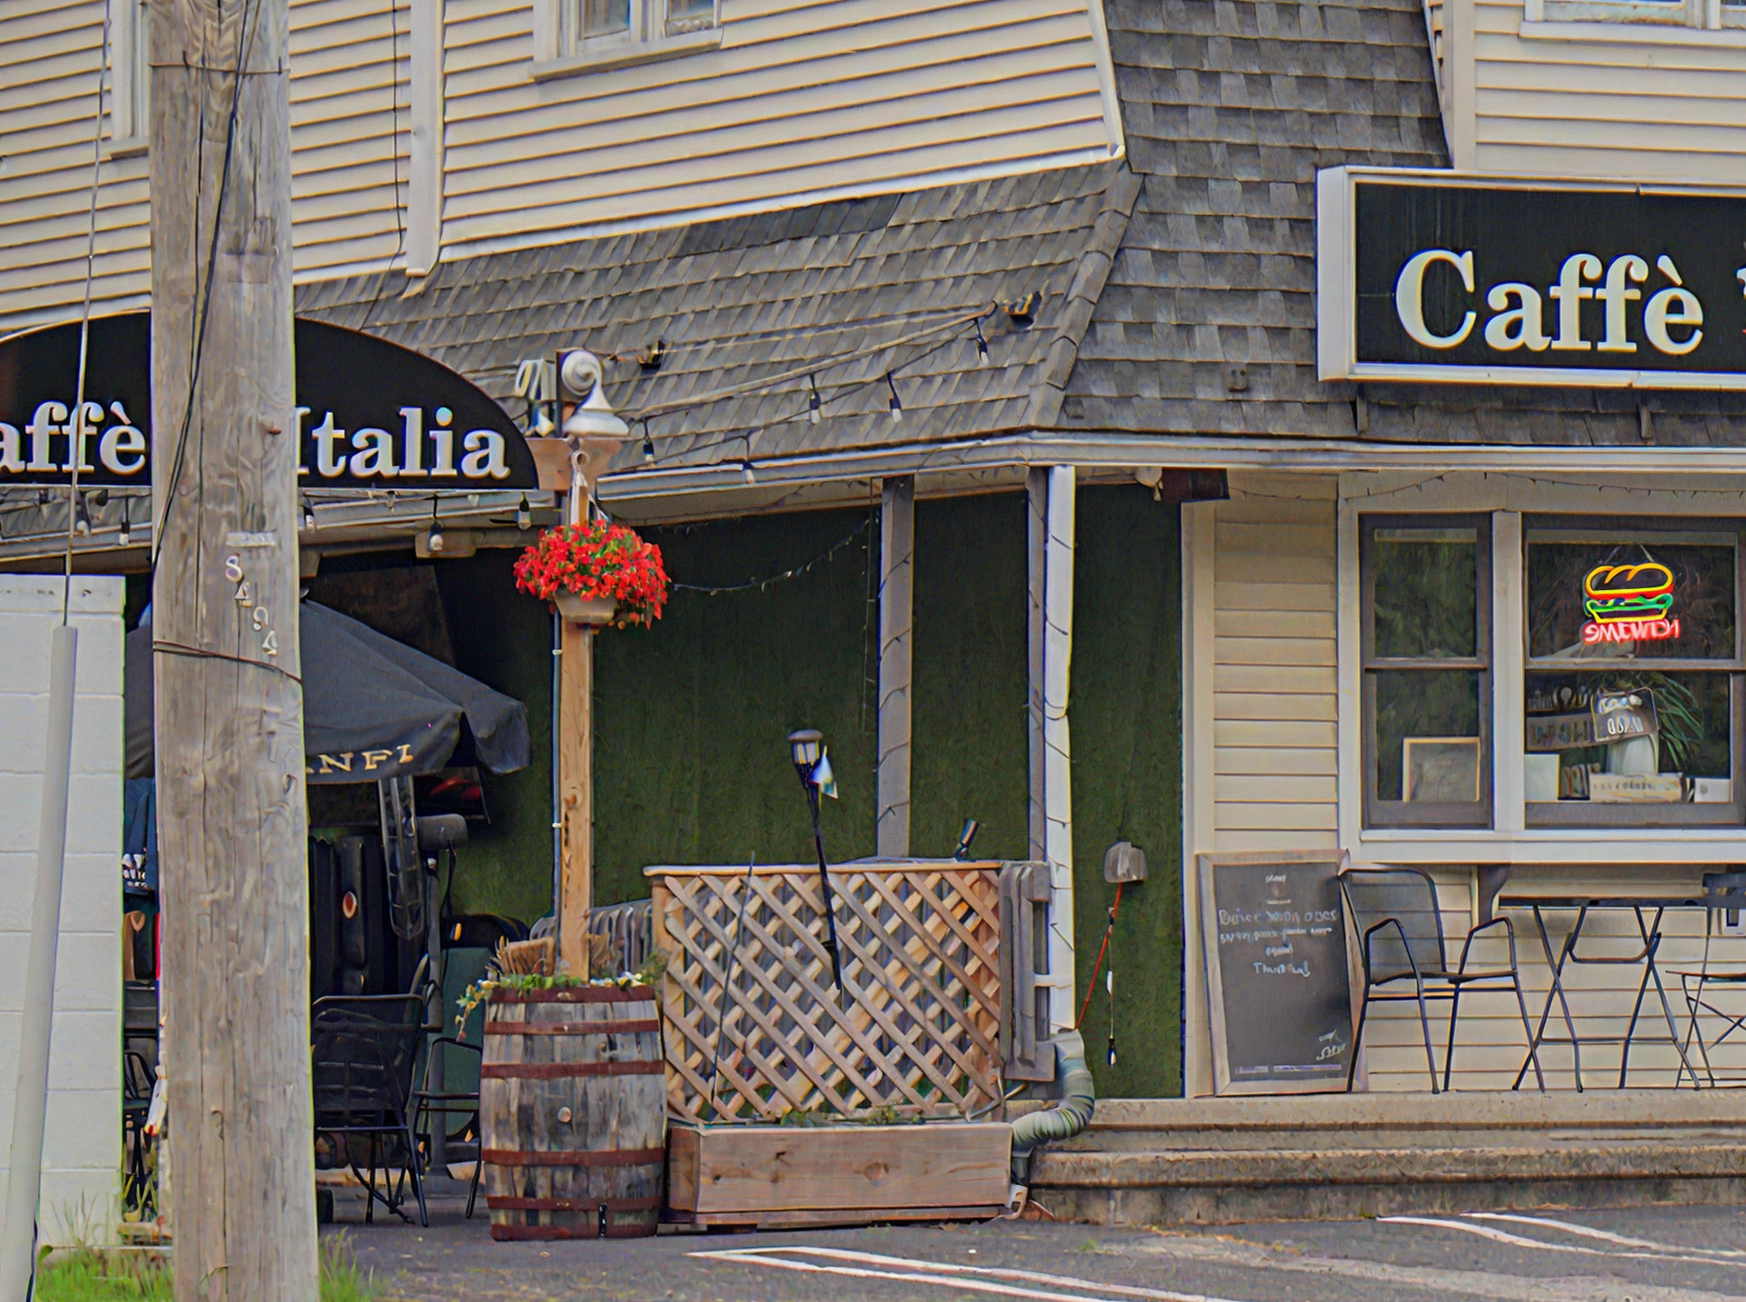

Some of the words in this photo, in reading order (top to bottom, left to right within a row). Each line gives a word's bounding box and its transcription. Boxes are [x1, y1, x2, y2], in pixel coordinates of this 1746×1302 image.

[1395, 248, 1704, 356] Caffè
[0, 399, 147, 476] affè
[306, 743, 414, 774] NFI
